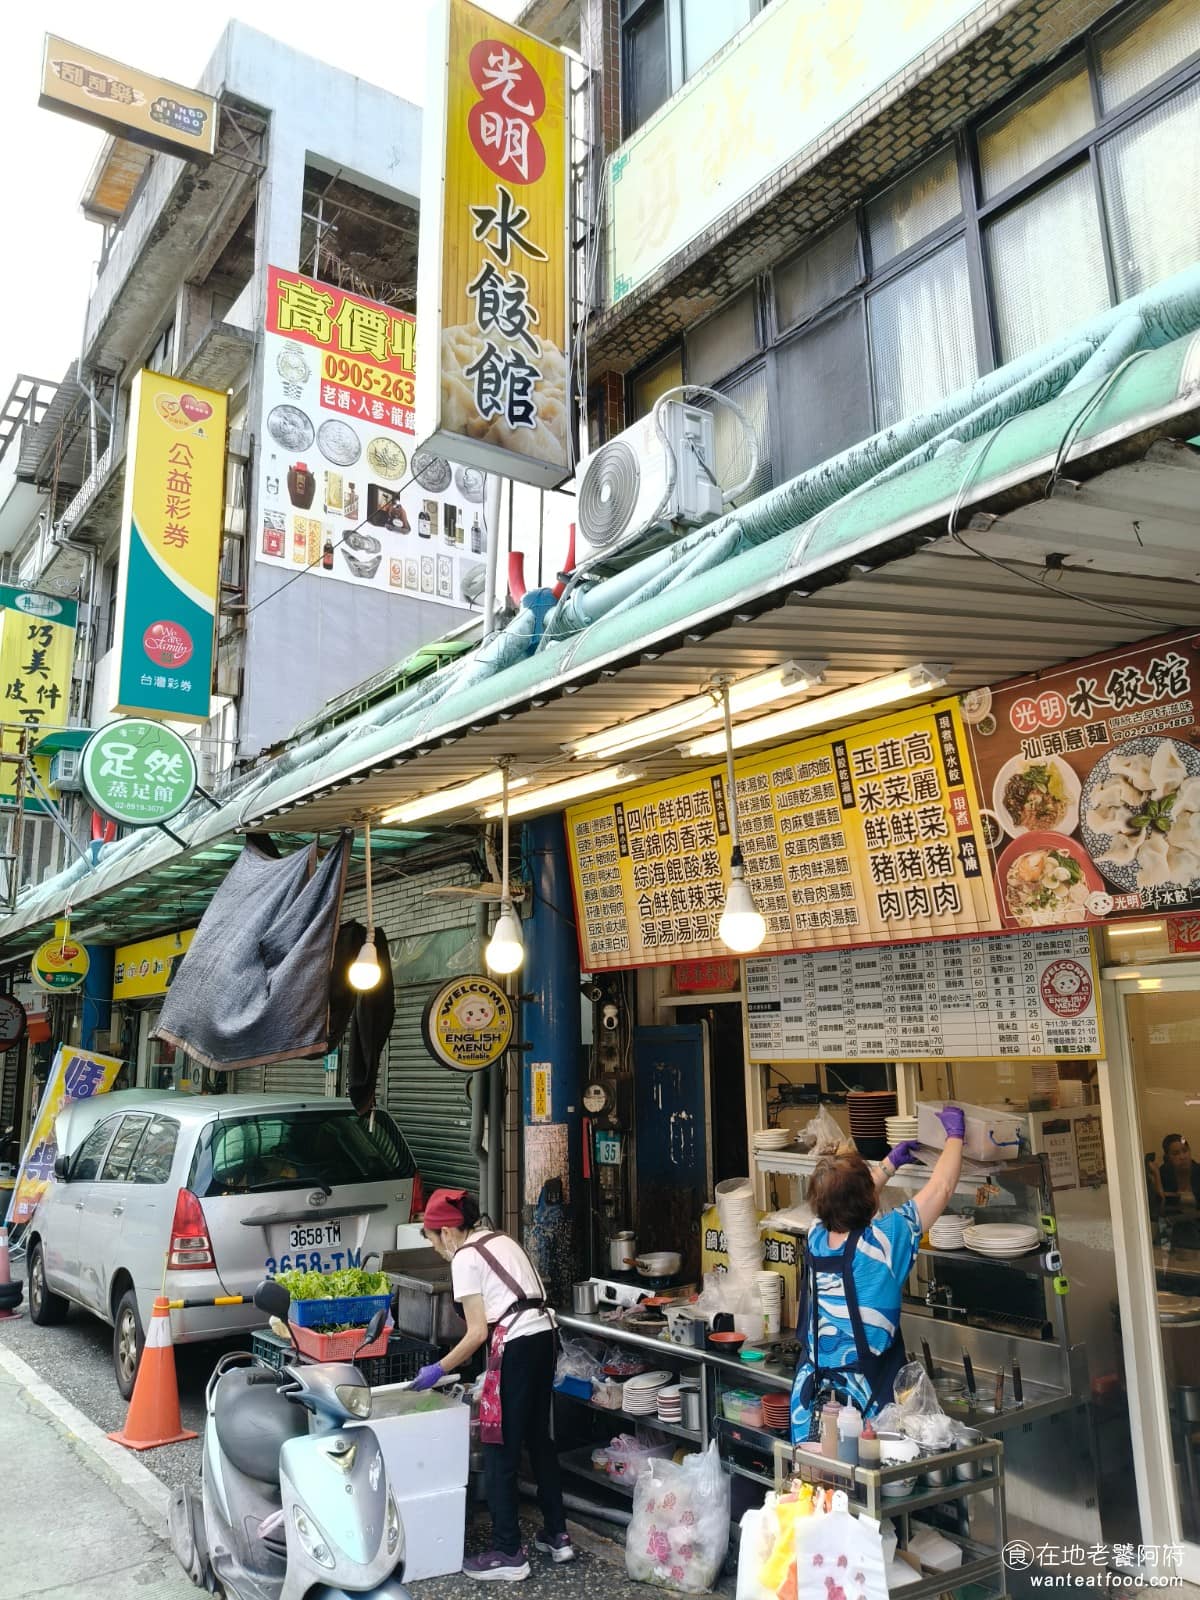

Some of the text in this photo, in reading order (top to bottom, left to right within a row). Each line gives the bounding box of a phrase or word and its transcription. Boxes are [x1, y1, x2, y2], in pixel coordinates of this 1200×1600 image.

[481, 47, 535, 180] 光明
[465, 185, 548, 428] 水餃館
[163, 443, 194, 549] 公益彩券
[140, 674, 192, 692] 台灣彩券
[1015, 654, 1190, 729] 光明 水餃館
[1022, 722, 1108, 760] 汕頭意麵
[99, 742, 184, 784] 足然
[904, 731, 960, 914] 高麗菜豬肉
[953, 797, 969, 826] 現煮
[852, 746, 901, 919] 玉米鮮豬肉
[961, 842, 978, 871] 冷凍
[627, 809, 657, 945] 四喜綜合湯
[643, 804, 674, 943] 什錦海鮮湯
[1022, 940, 1032, 948] 20
[1024, 963, 1034, 971] 20
[1025, 974, 1035, 982] 20
[1043, 962, 1089, 987] WELCOME
[441, 983, 506, 1016] WELCOME
[1026, 986, 1036, 994] 20
[1049, 995, 1087, 1004] ENGLISH
[446, 1033, 501, 1042] ENGLISH
[453, 1043, 492, 1052] MENU
[604, 1144, 616, 1161] 35
[766, 1239, 796, 1264] 滷味
